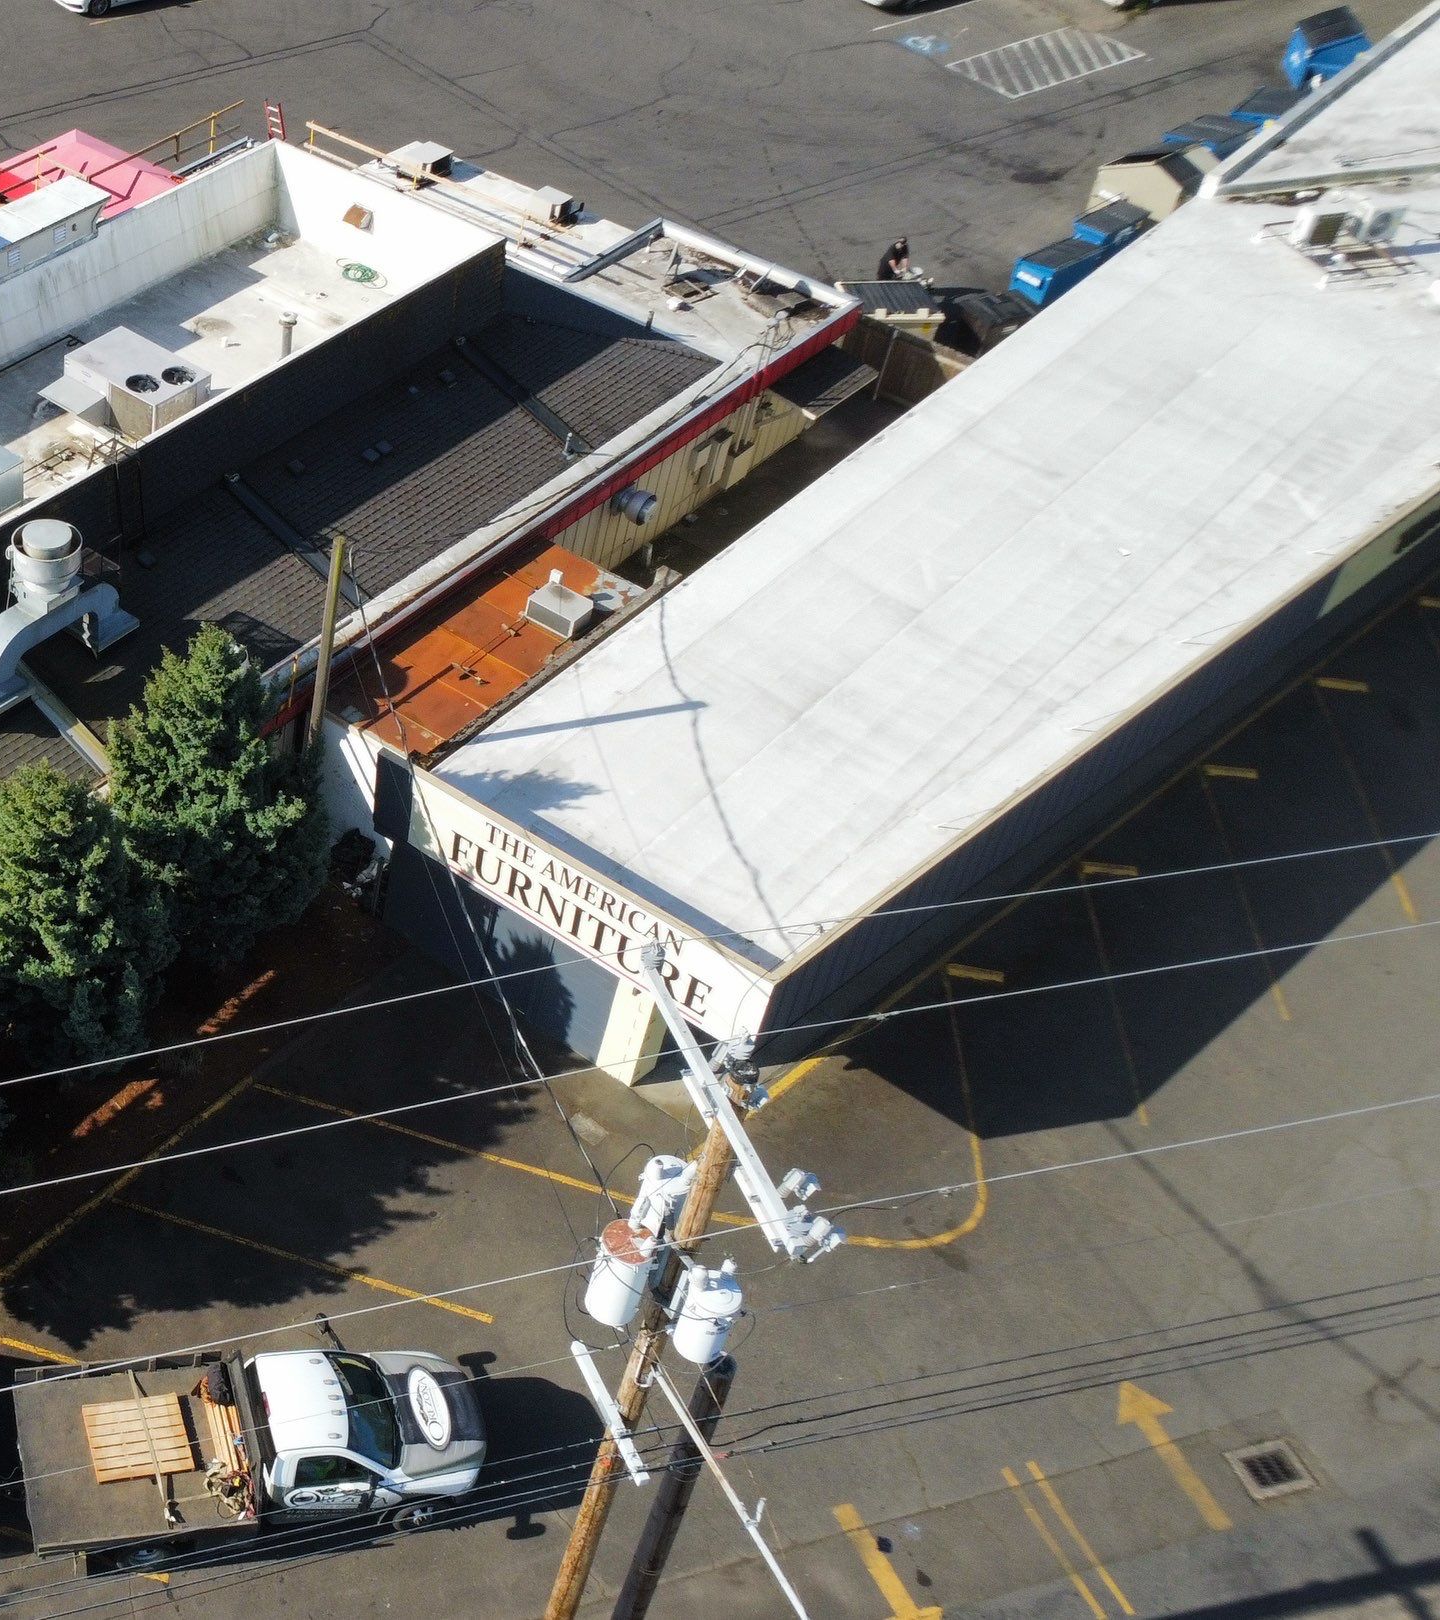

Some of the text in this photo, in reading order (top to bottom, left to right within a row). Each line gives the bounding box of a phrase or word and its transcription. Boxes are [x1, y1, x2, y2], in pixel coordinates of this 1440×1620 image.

[448, 829, 713, 1017] FURNITURE
[485, 821, 685, 957] THE AMERICAN
